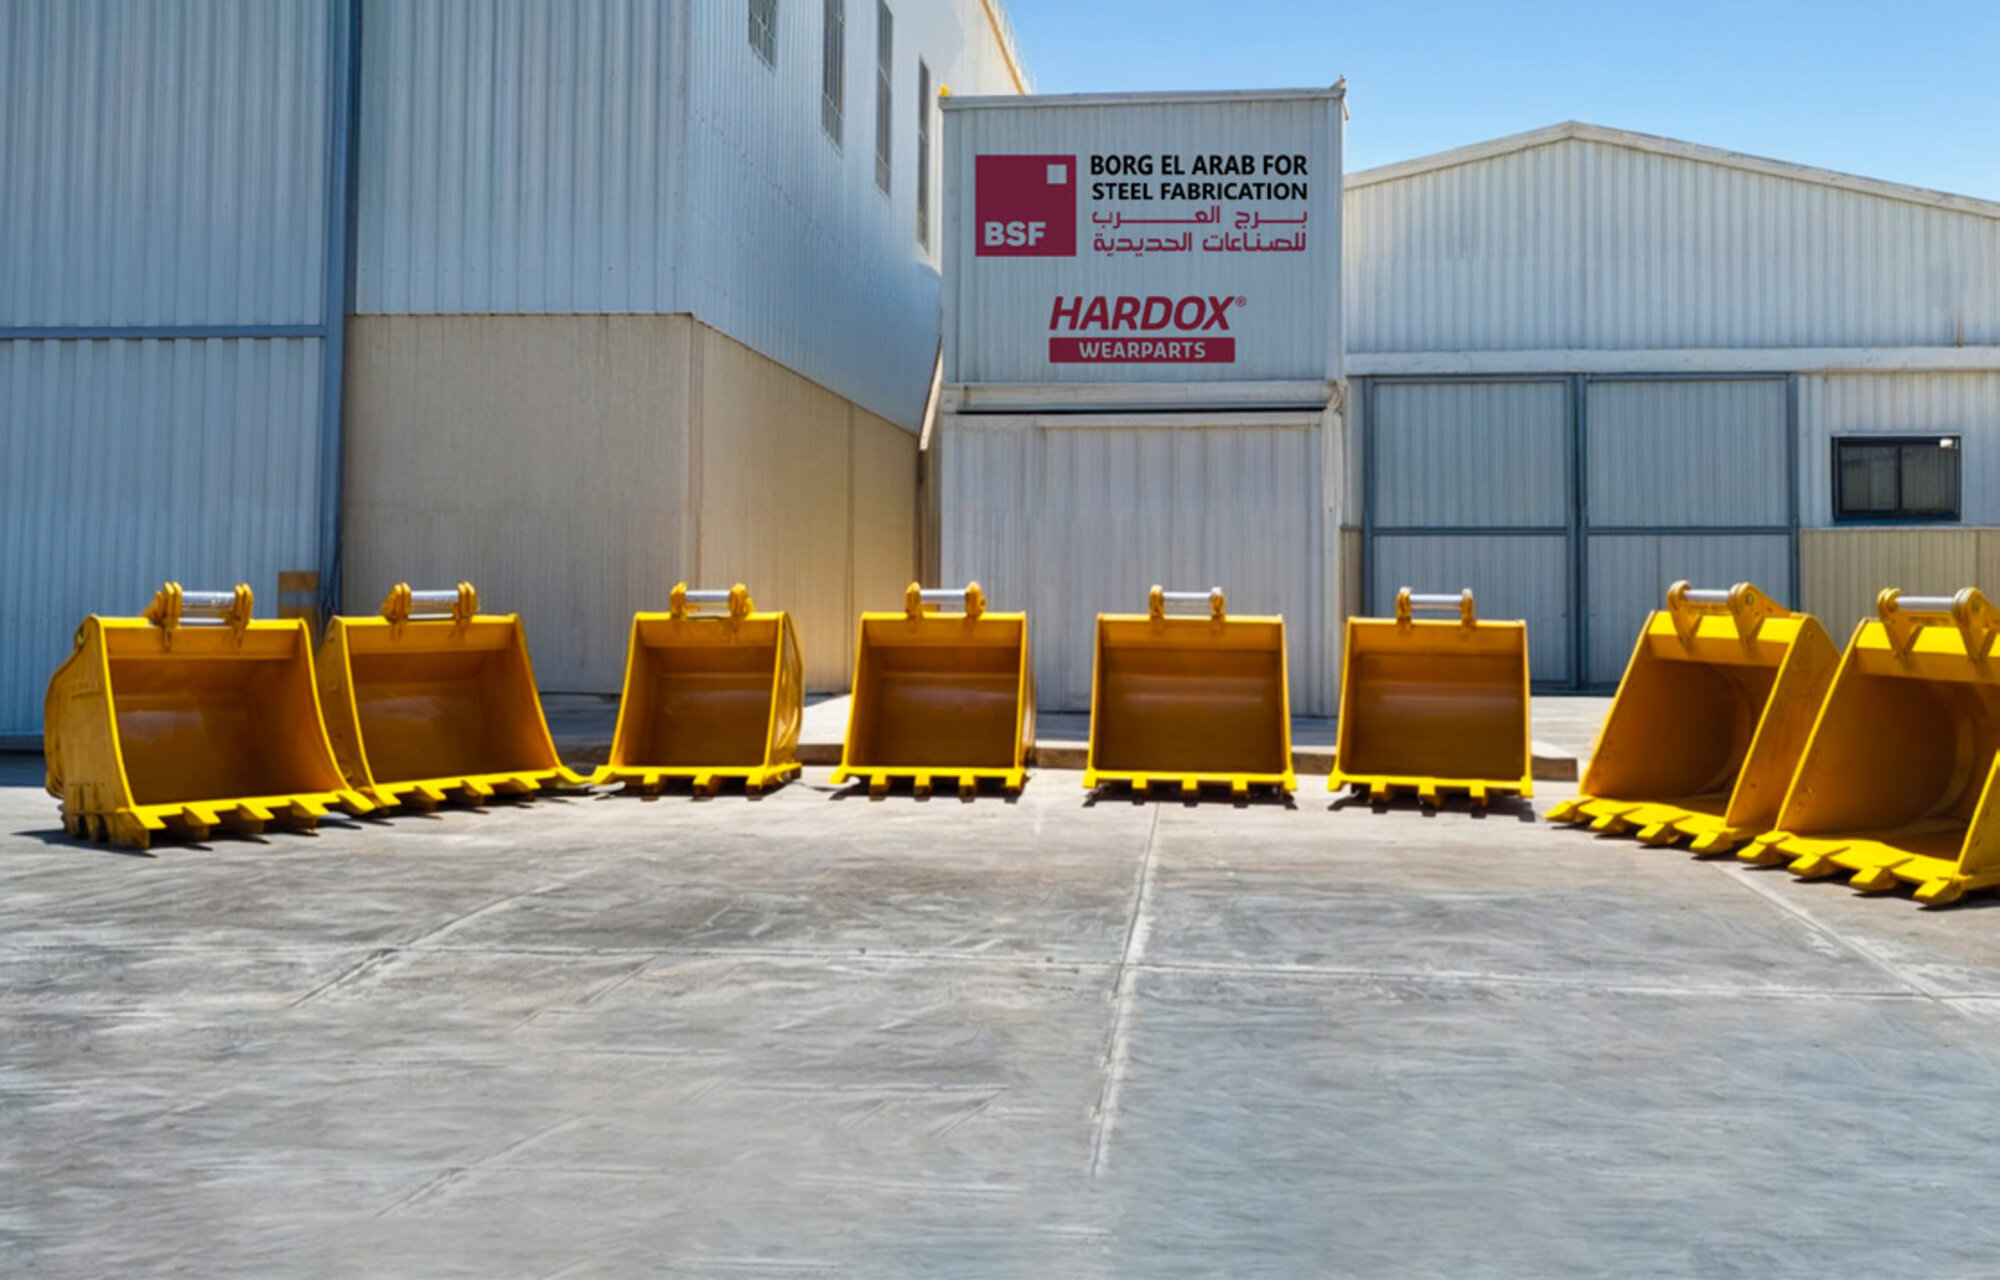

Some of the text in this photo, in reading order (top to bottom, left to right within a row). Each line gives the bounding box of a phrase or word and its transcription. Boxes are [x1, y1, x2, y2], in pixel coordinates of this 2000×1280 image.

[1090, 154, 1308, 175] BORG EL ARAB FOR
[1092, 182, 1308, 200] STEEL FABRICATION
[984, 221, 1047, 247] BSF
[1093, 232, 1306, 257] للصناعات الحديدية
[1079, 342, 1206, 359] WEARPARTS
